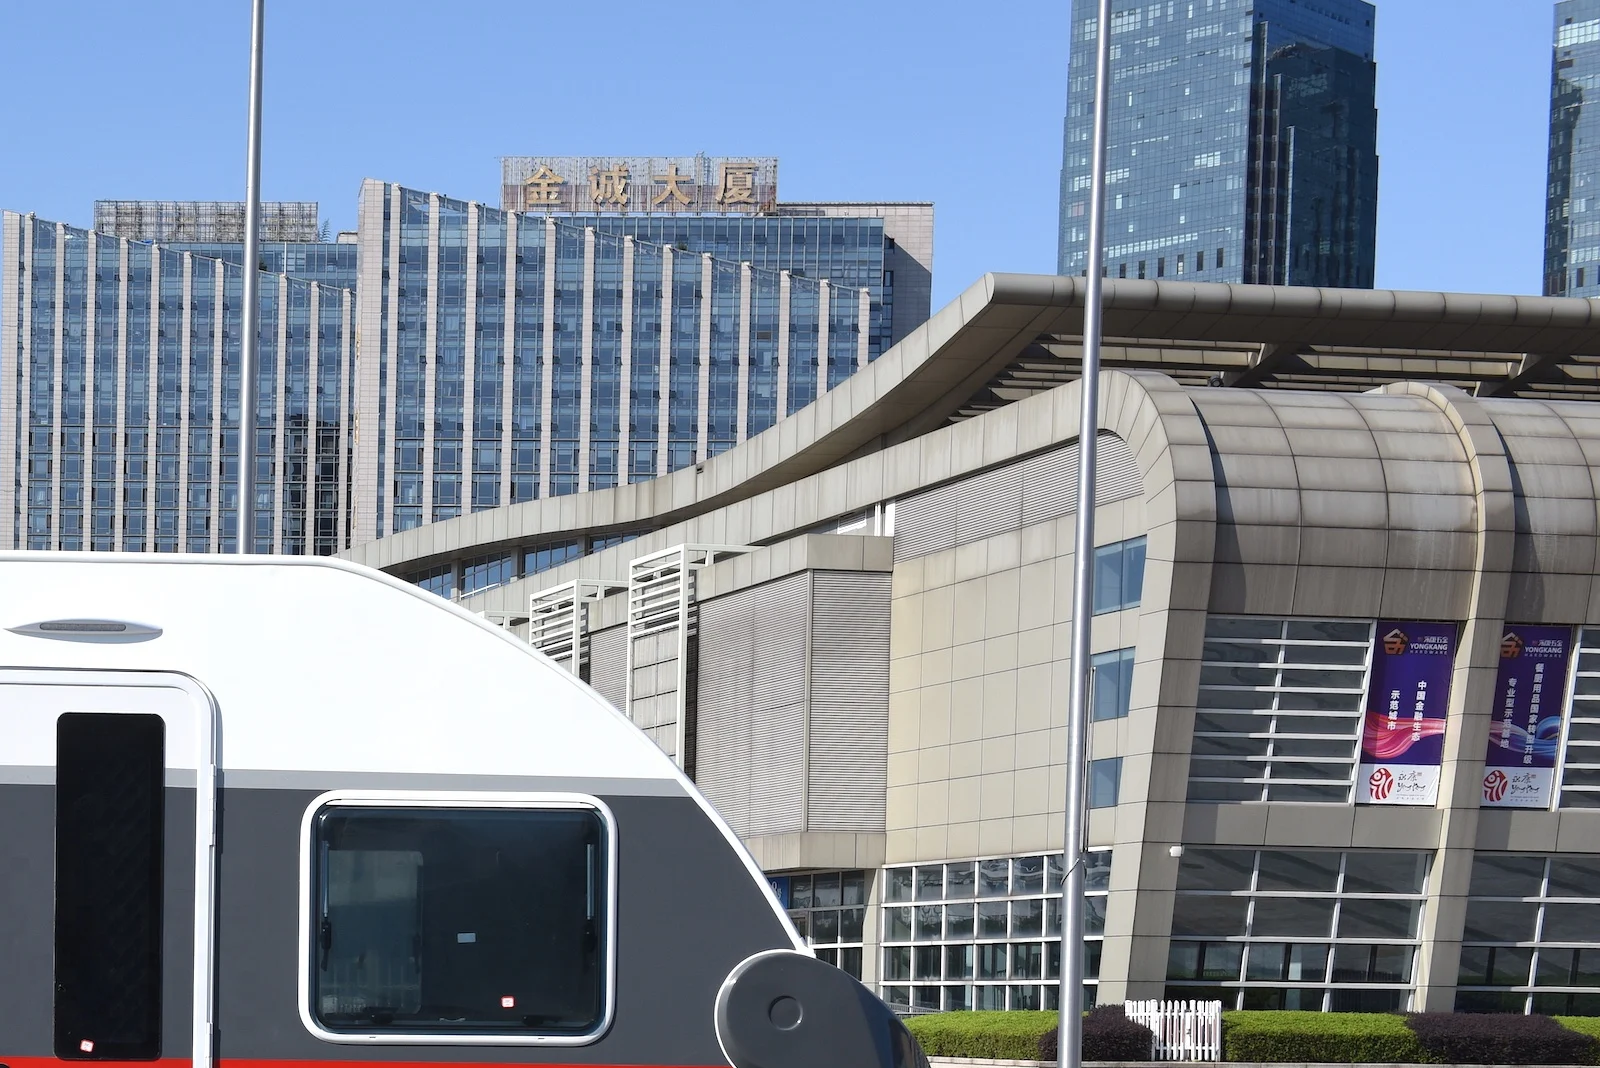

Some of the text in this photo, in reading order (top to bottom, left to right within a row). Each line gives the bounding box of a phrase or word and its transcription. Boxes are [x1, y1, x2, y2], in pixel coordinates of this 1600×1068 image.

[524, 163, 758, 205] 金诚大厦
[1524, 646, 1562, 654] YONGKANG
[1387, 690, 1401, 730] 示范城市
[1411, 680, 1427, 741] 中国金融生态
